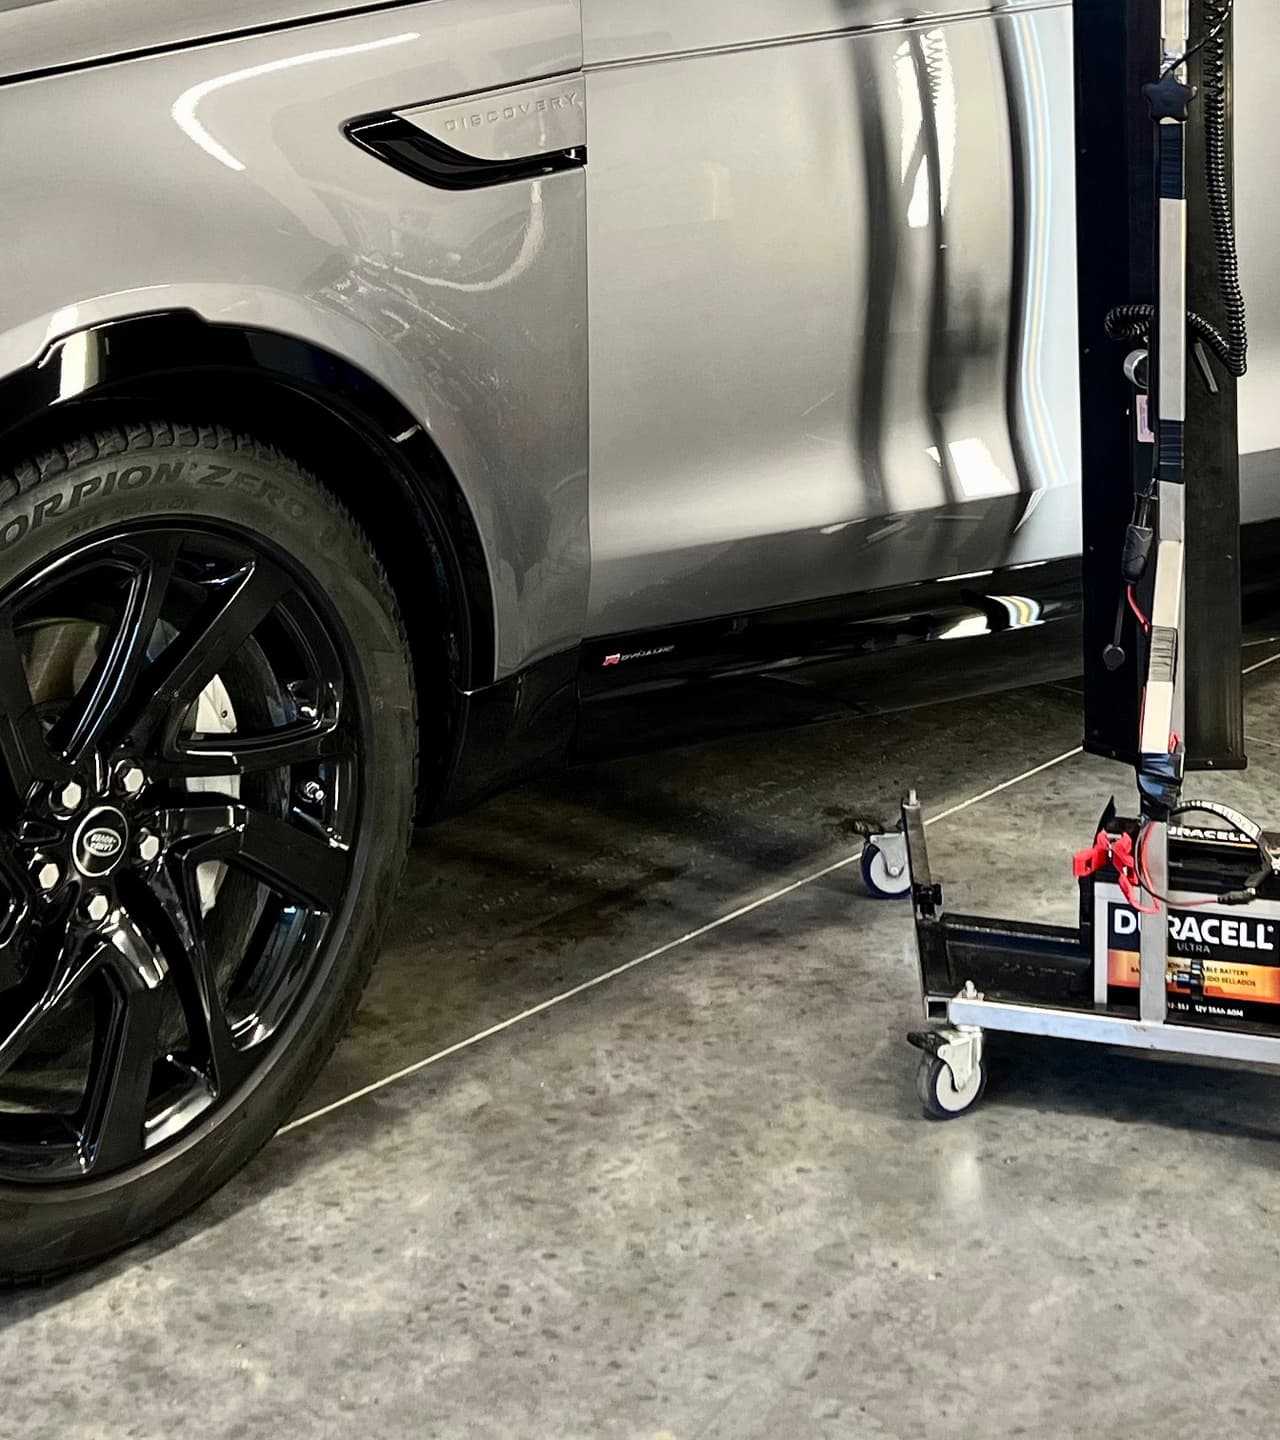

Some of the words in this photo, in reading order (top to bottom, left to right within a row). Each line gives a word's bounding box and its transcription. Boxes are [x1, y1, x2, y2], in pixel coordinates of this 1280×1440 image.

[445, 92, 576, 131] DISCOVERY
[198, 465, 309, 523] ZERO
[1114, 909, 1273, 950] DRACELL
[1176, 942, 1211, 954] ULTRA
